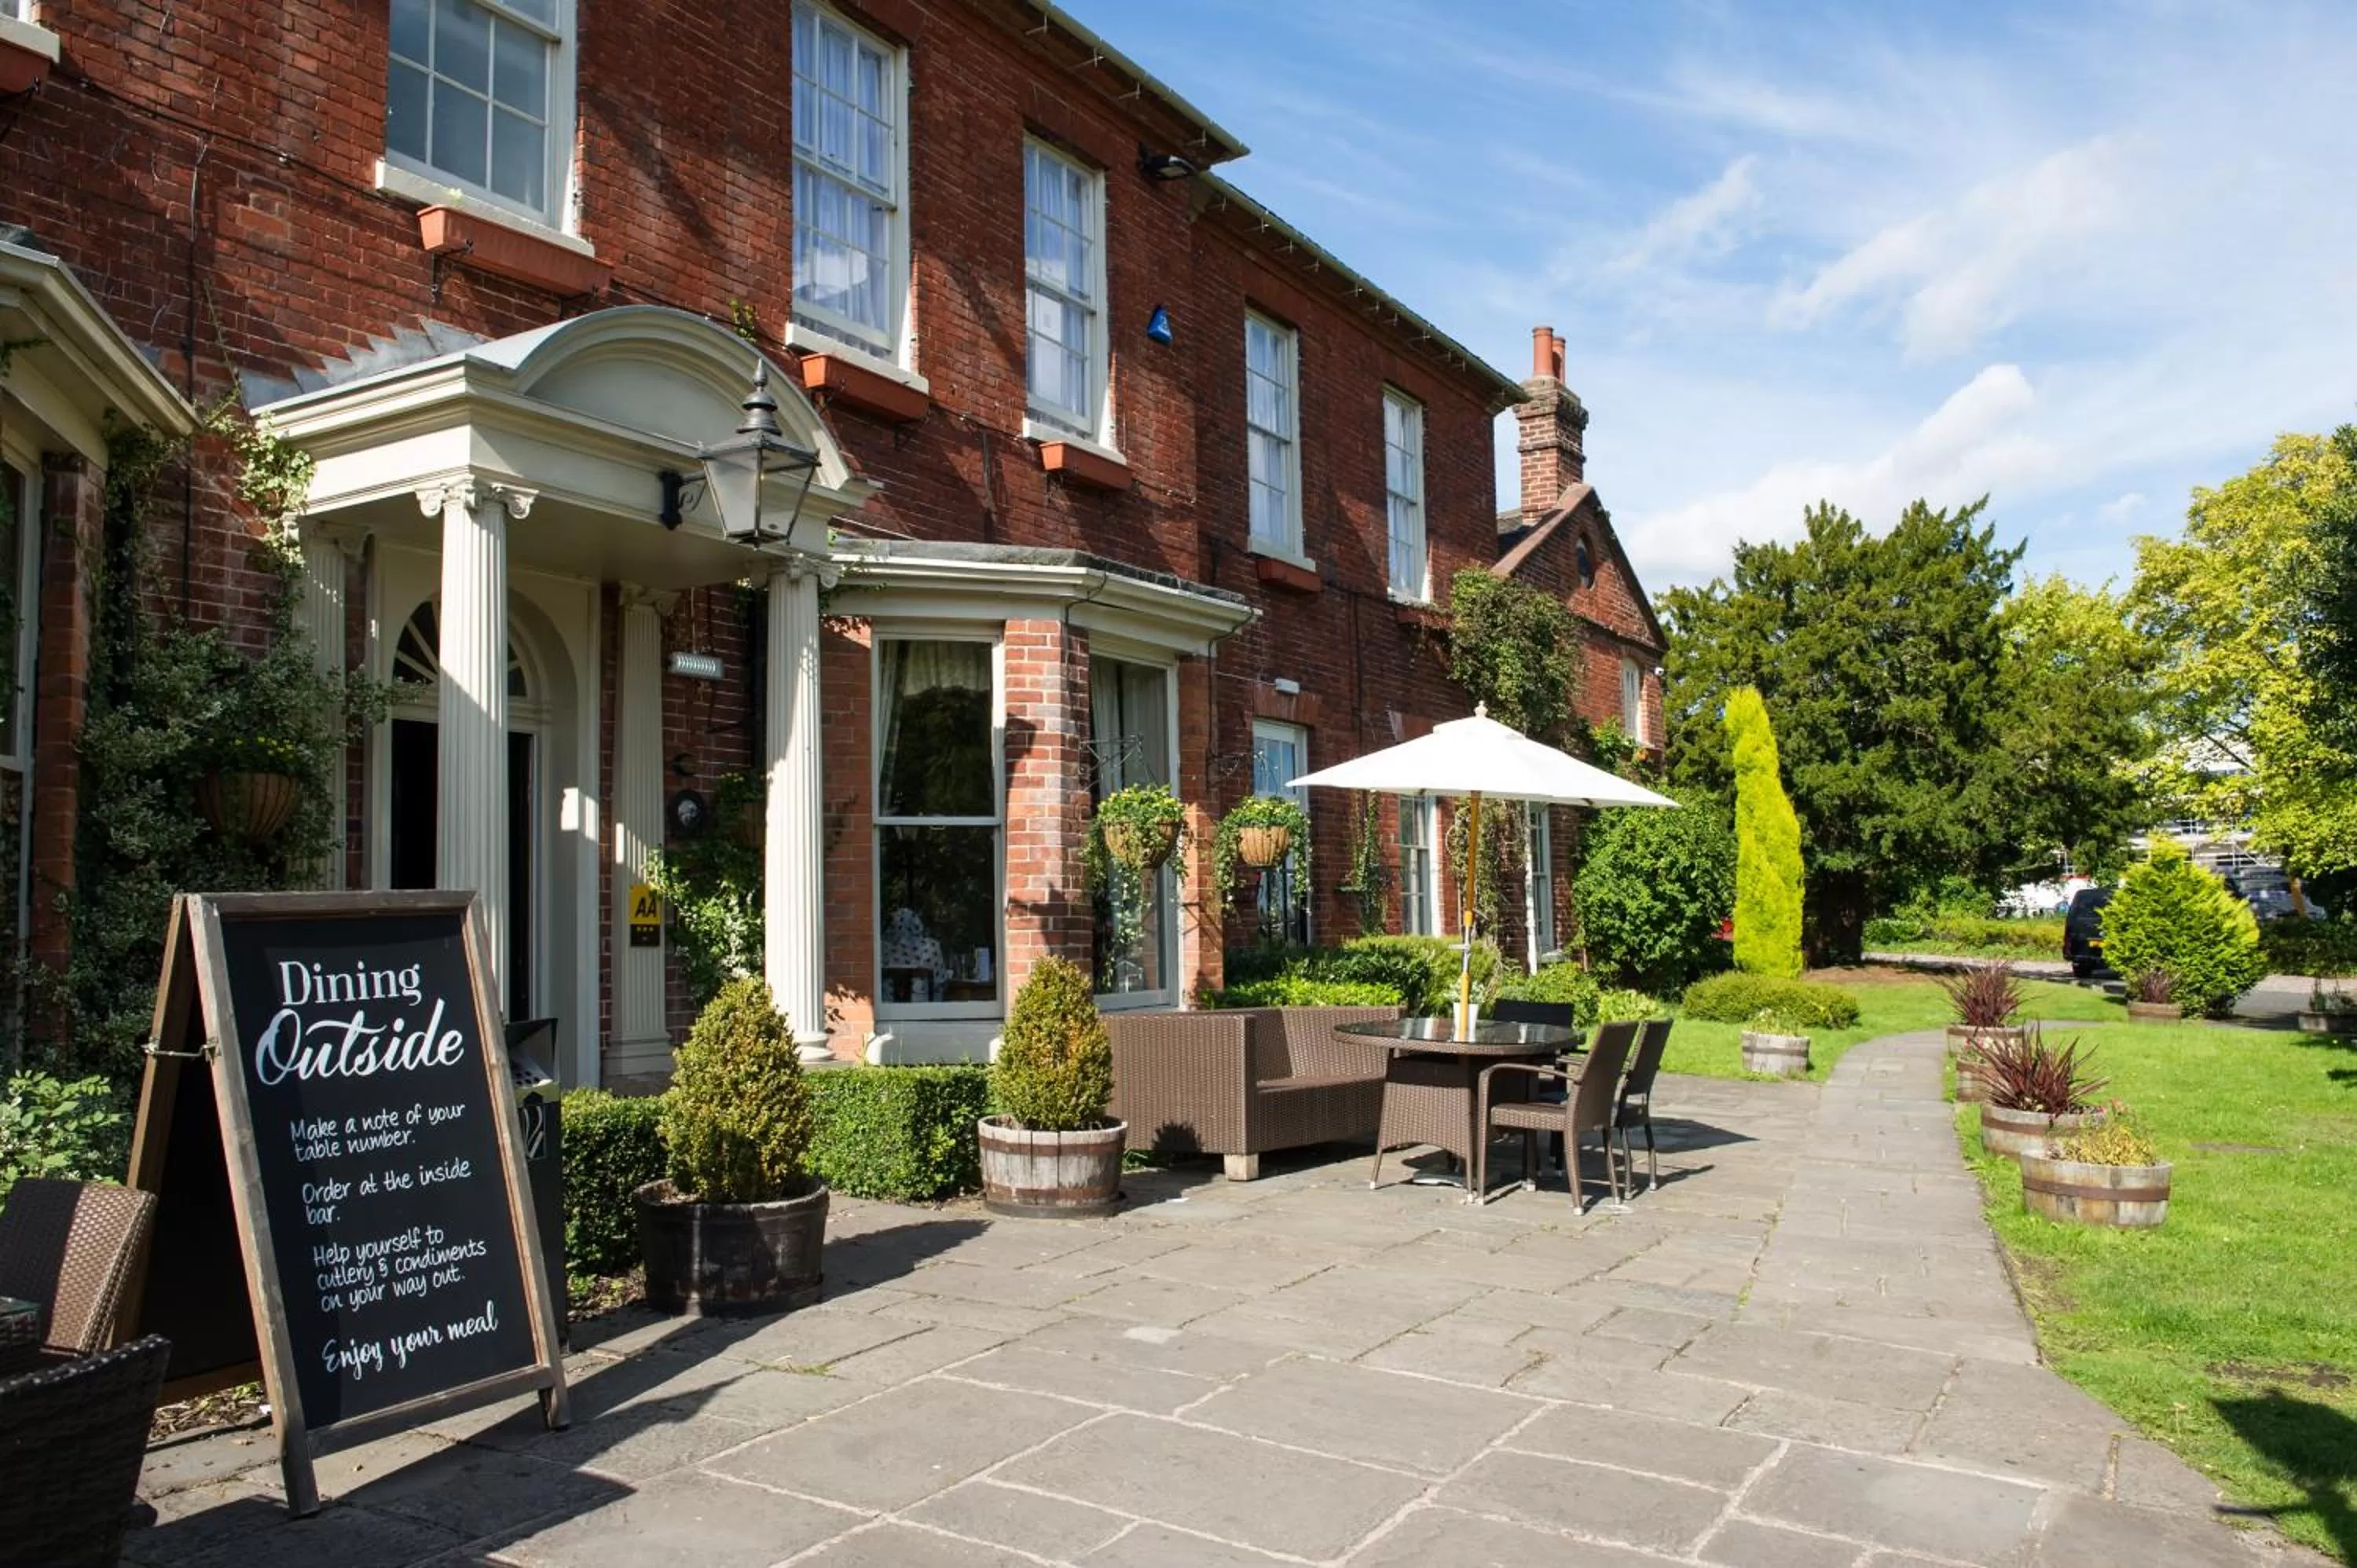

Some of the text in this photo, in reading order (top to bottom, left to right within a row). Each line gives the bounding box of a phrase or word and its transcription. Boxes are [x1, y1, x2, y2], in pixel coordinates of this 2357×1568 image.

[635, 896, 658, 918] AA
[278, 960, 423, 1006] Dining
[255, 997, 464, 1086] Outside
[290, 1103, 466, 1141] Make a note of your
[294, 1129, 416, 1163] table number.
[302, 1156, 472, 1203] Order at the inside
[306, 1204, 340, 1225] bar.
[313, 1225, 444, 1267] Help yourself to
[317, 1264, 376, 1291] cutlery
[395, 1239, 487, 1275] condiments
[321, 1263, 466, 1312] on your way out.
[321, 1299, 500, 1380] Enjoy your meal
